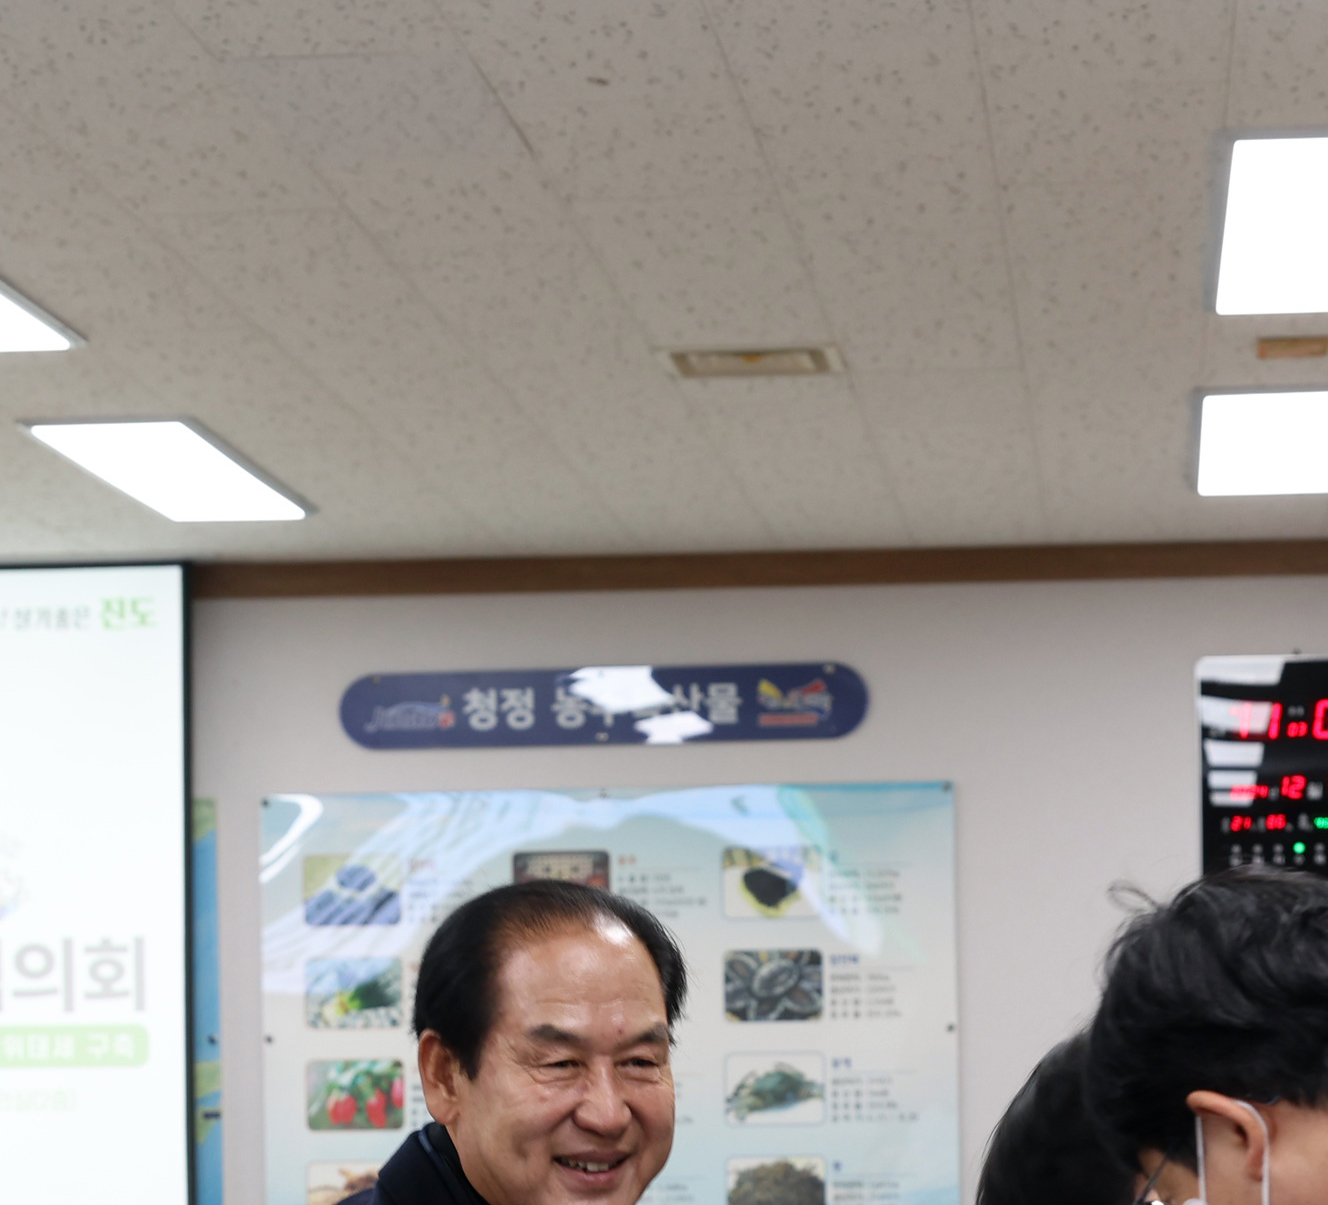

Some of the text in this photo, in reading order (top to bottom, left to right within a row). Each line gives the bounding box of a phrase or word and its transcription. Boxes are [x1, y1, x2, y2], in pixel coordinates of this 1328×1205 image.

[100, 596, 155, 631] 진도
[462, 686, 535, 732] 청정
[1280, 774, 1307, 799] 12
[84, 1031, 135, 1060] 구축
